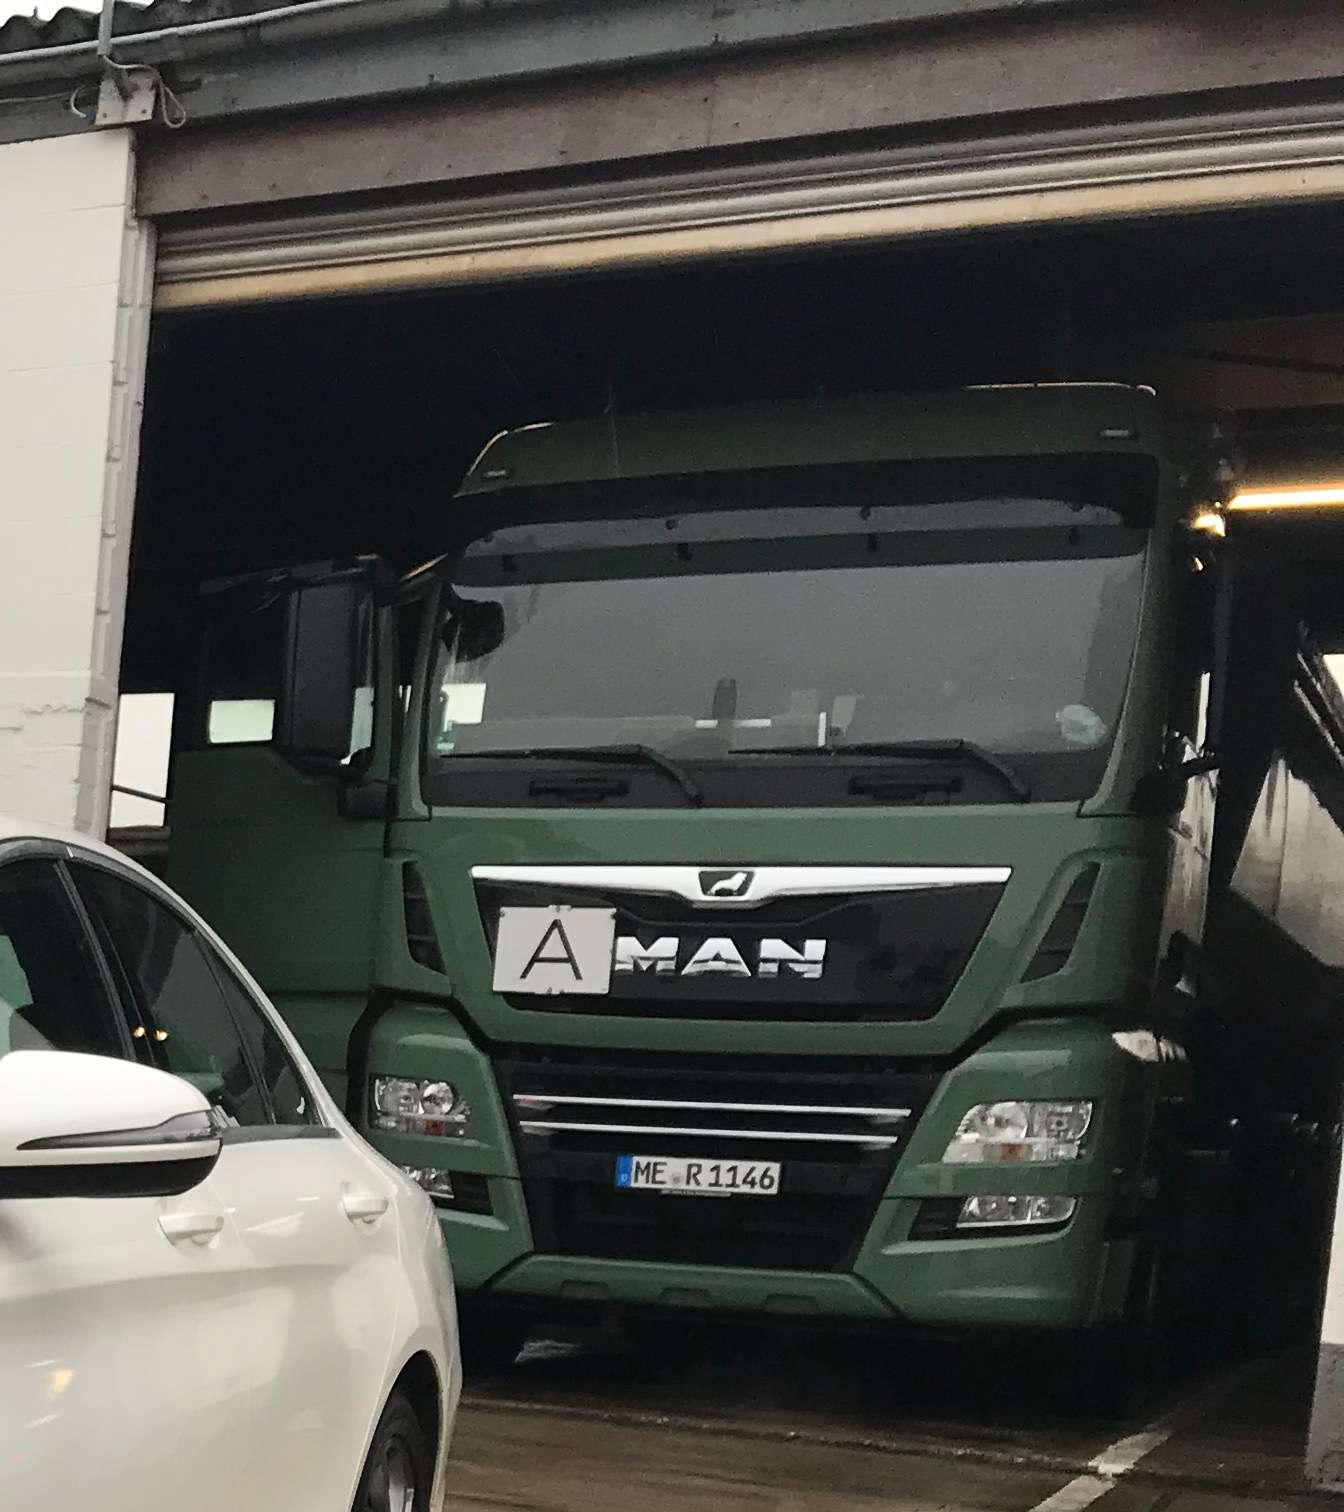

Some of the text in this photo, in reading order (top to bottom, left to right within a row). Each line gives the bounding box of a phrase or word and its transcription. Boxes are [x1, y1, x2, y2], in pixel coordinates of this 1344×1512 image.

[519, 917, 584, 981] A
[615, 936, 827, 979] MAN
[633, 1161, 775, 1190] ME R 1146
